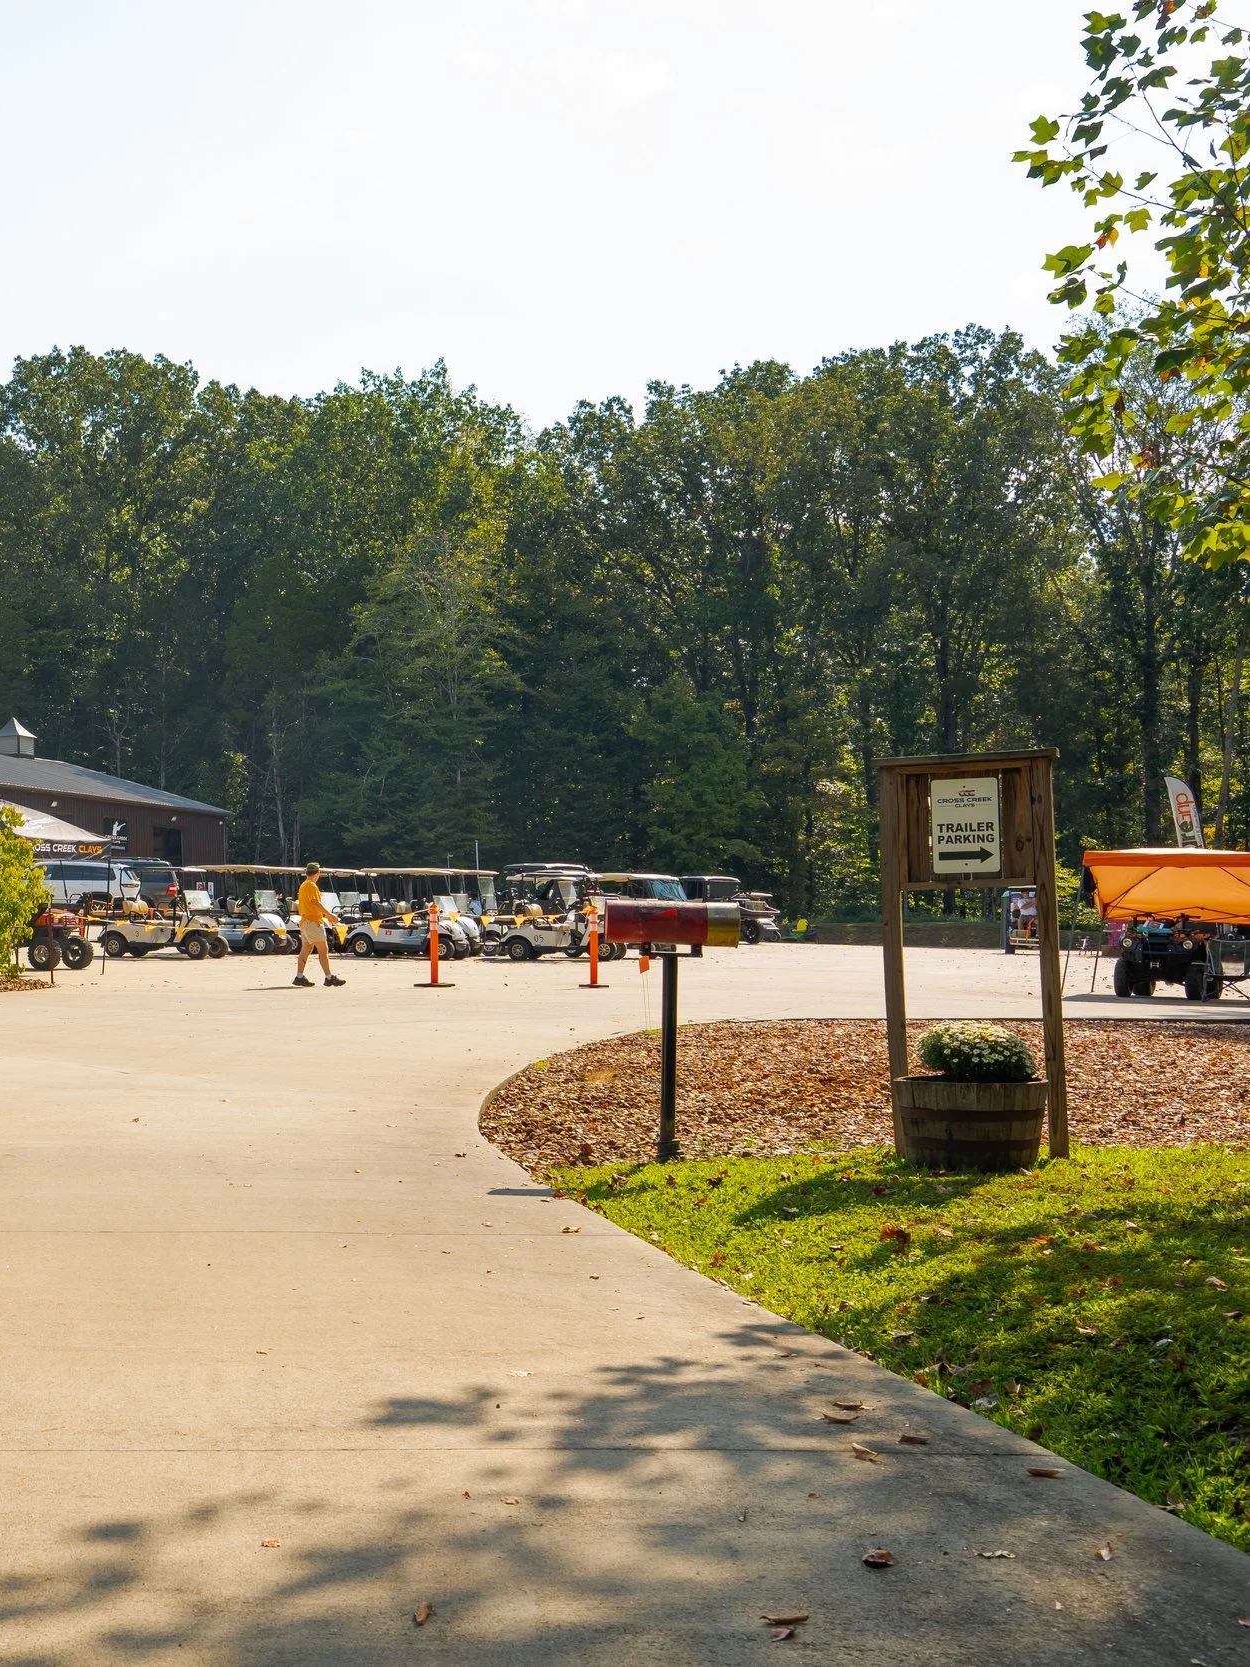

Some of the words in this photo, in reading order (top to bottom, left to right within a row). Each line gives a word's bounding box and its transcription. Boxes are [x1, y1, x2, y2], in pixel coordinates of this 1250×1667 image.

[937, 821, 995, 834] TRAILER
[937, 833, 995, 845] PARKING
[52, 843, 78, 854] CREEK
[78, 844, 103, 855] CLAYS
[533, 934, 545, 943] 05
